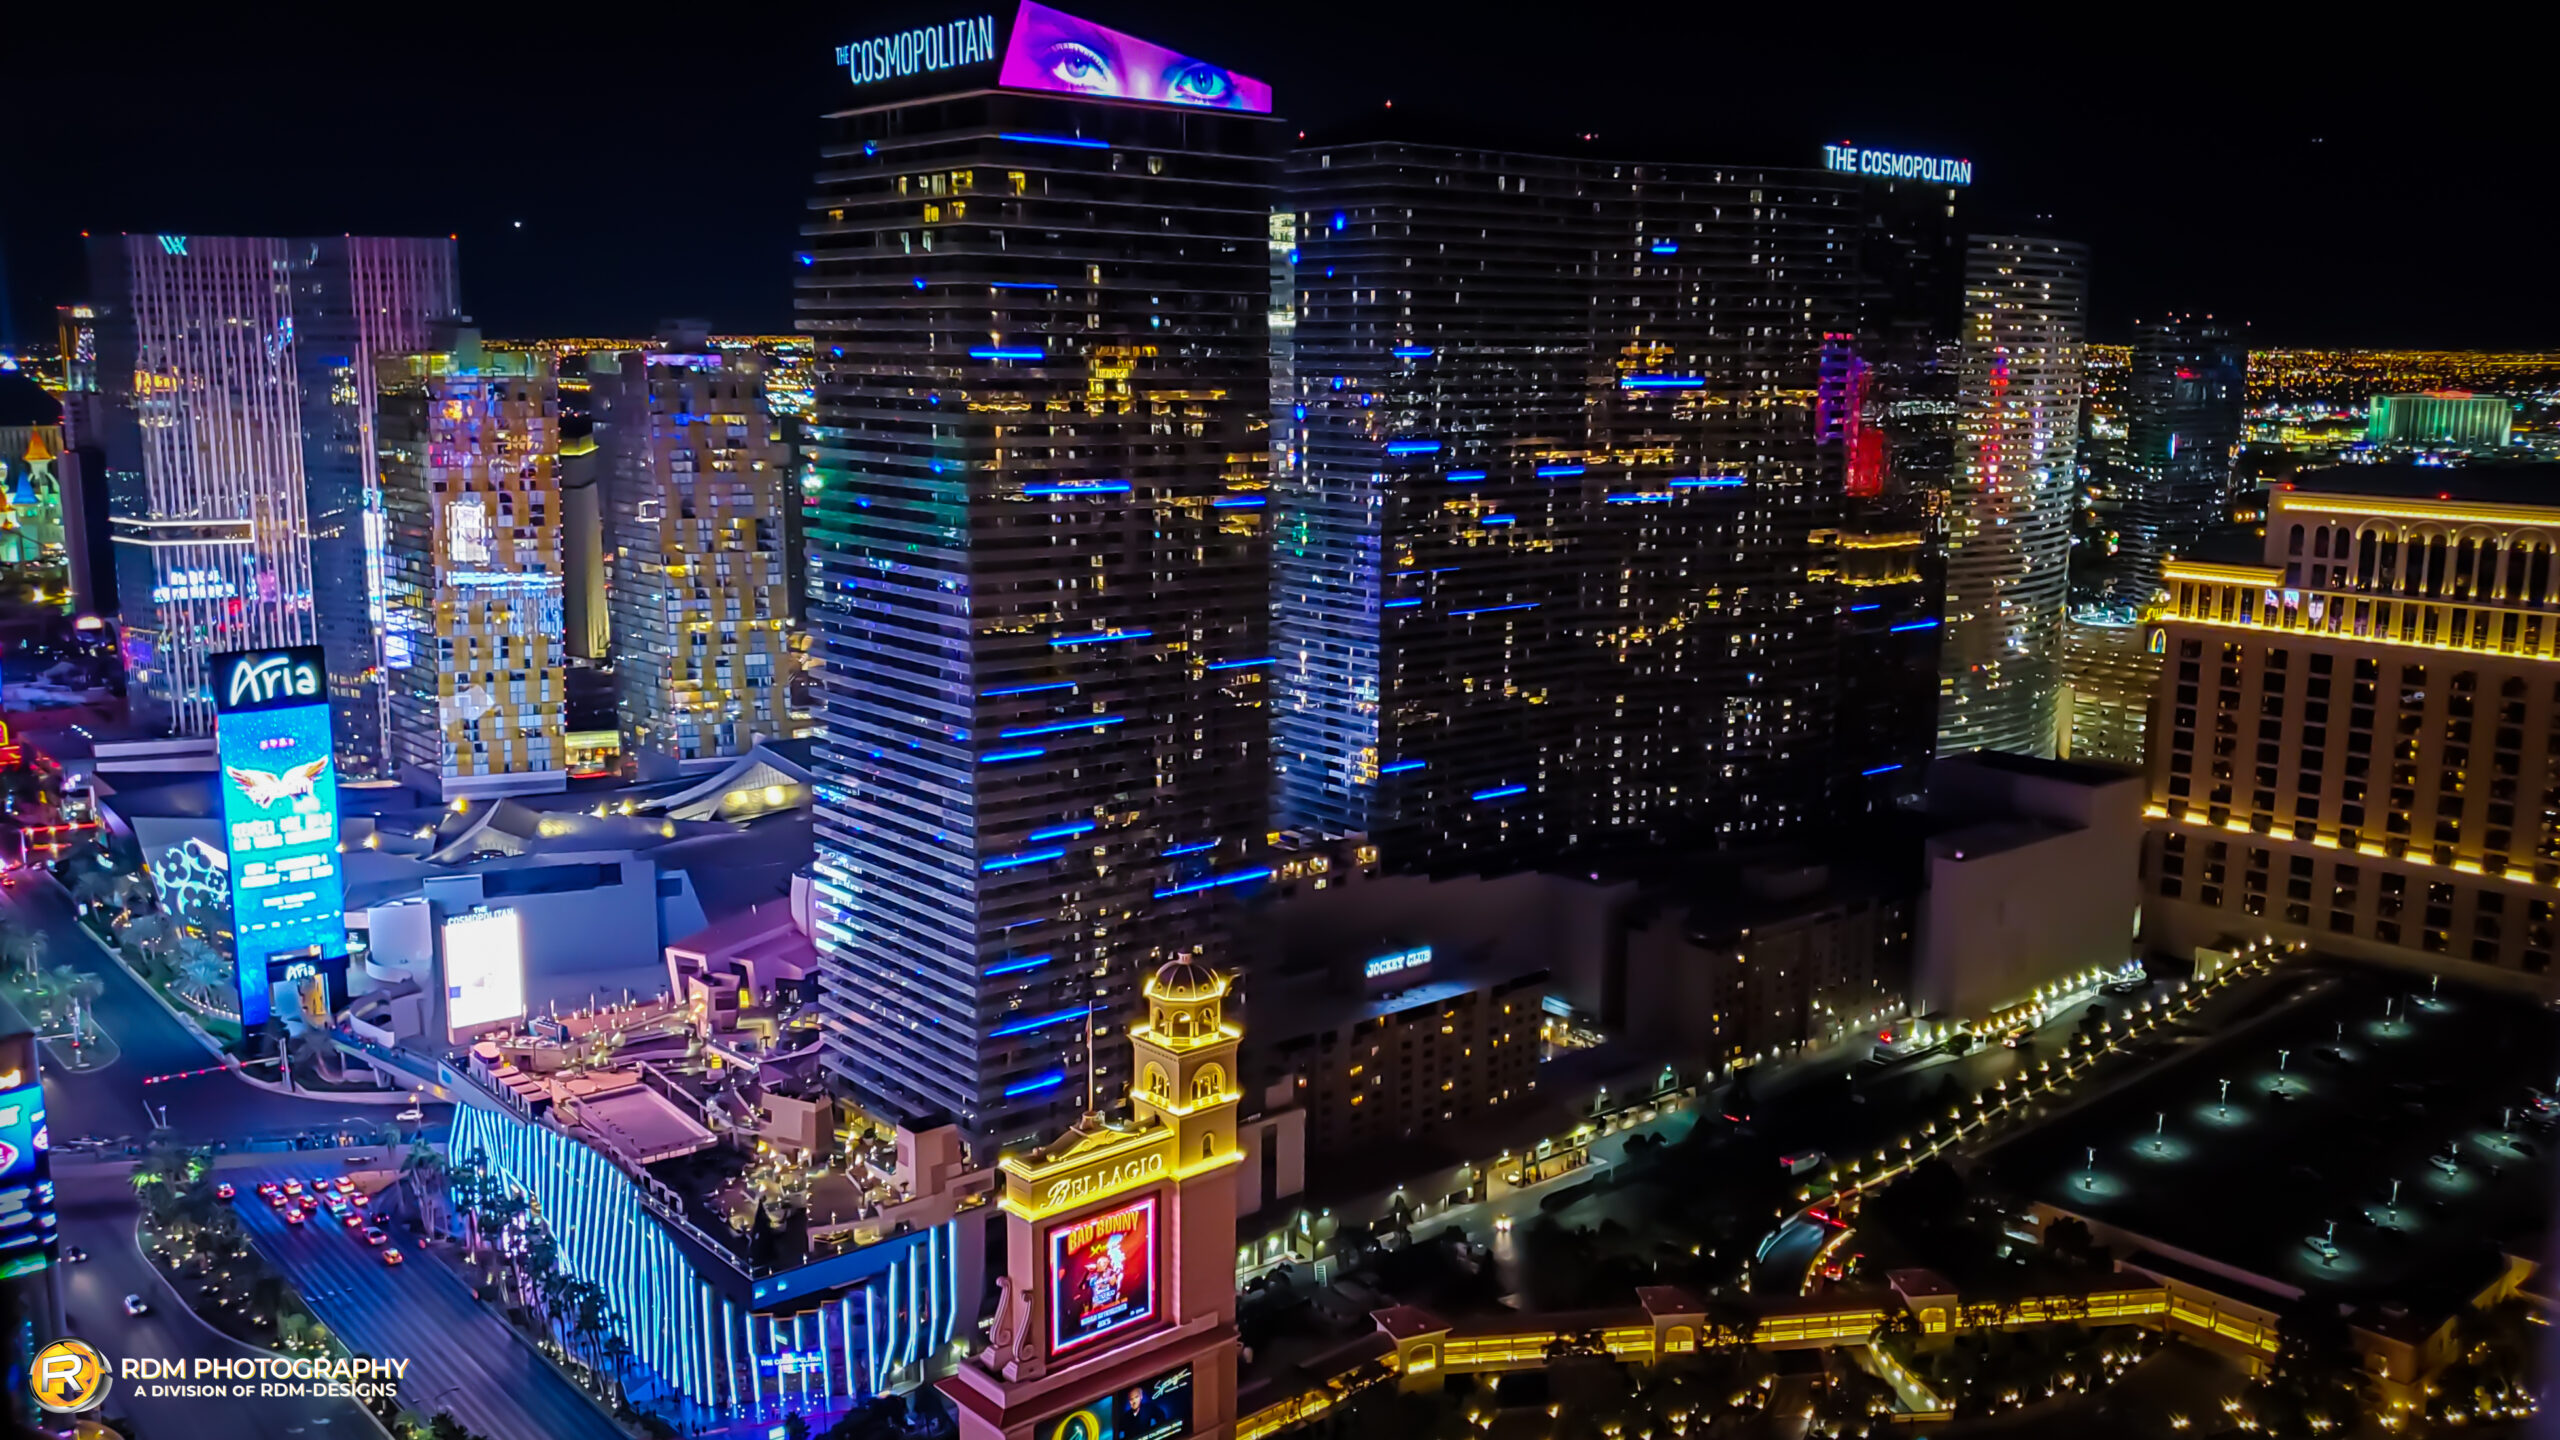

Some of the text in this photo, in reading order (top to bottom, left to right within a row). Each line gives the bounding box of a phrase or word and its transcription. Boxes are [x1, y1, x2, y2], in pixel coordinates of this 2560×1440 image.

[836, 15, 994, 85] THE COSMOPOLITAN
[1824, 145, 1972, 185] THE COSMOPOLITAN
[230, 657, 317, 707] Aria
[447, 907, 515, 926] COSMOPOLITAN
[1366, 949, 1432, 978] JOCKEY CLUB
[1068, 1224, 1094, 1255] BAD
[1096, 1211, 1139, 1240] BUNNY
